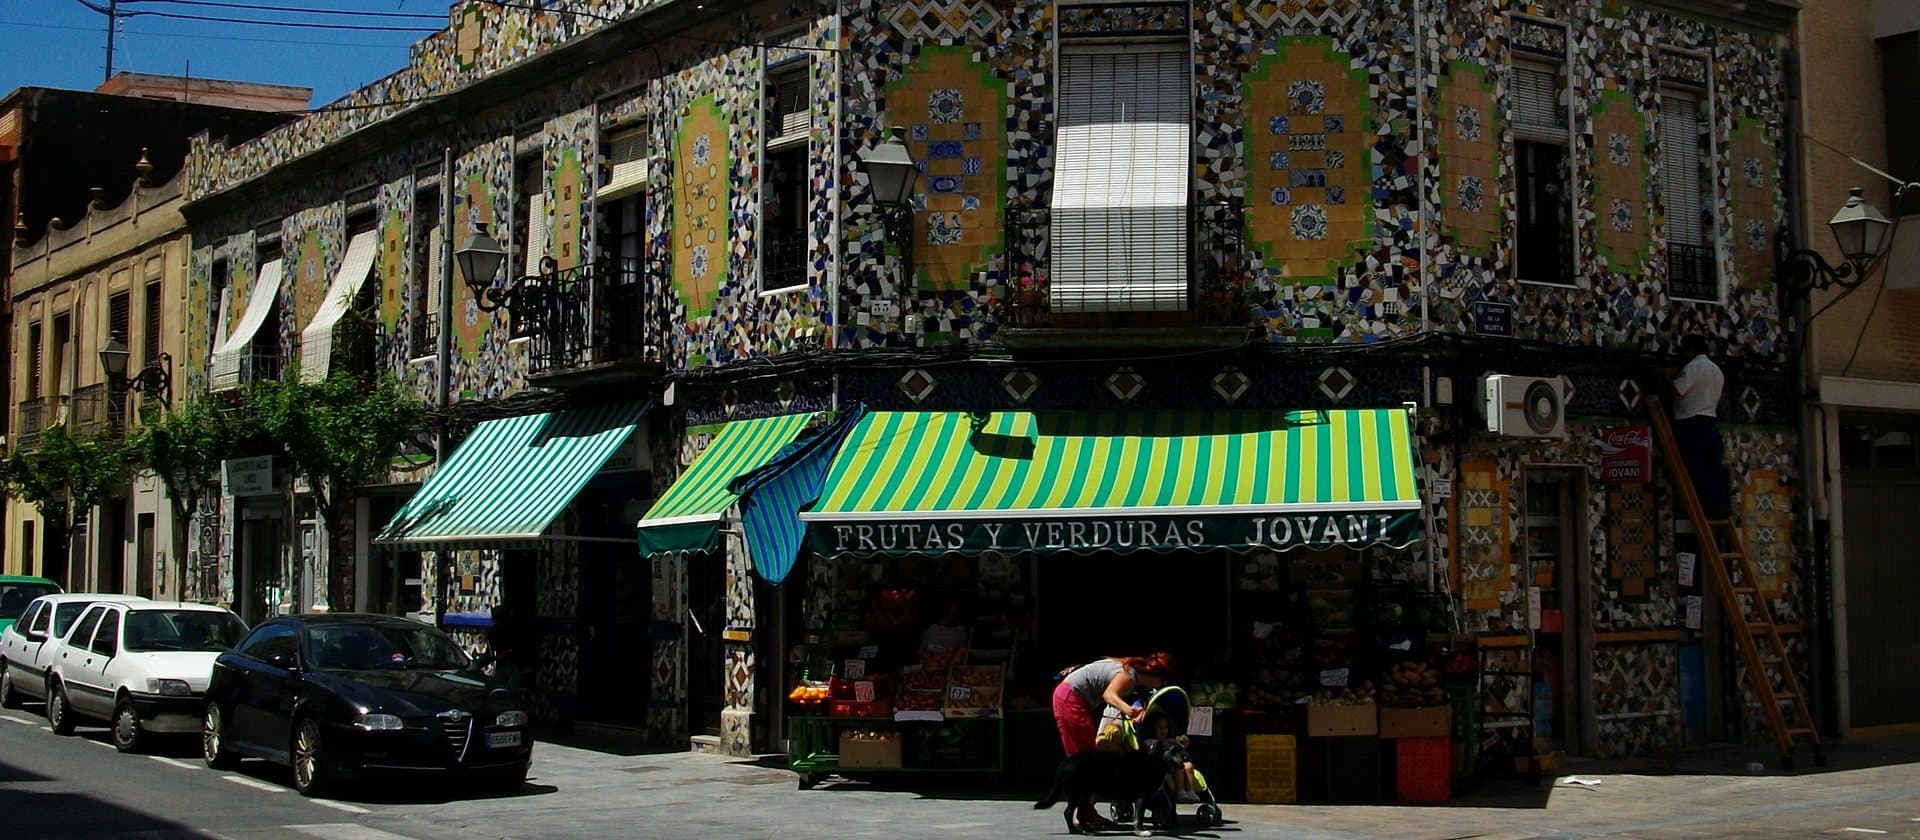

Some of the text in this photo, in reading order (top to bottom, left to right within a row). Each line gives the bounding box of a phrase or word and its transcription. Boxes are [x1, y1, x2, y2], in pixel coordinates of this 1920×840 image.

[833, 514, 1392, 551] FRUTAS Y VERDURAS JOVANI
